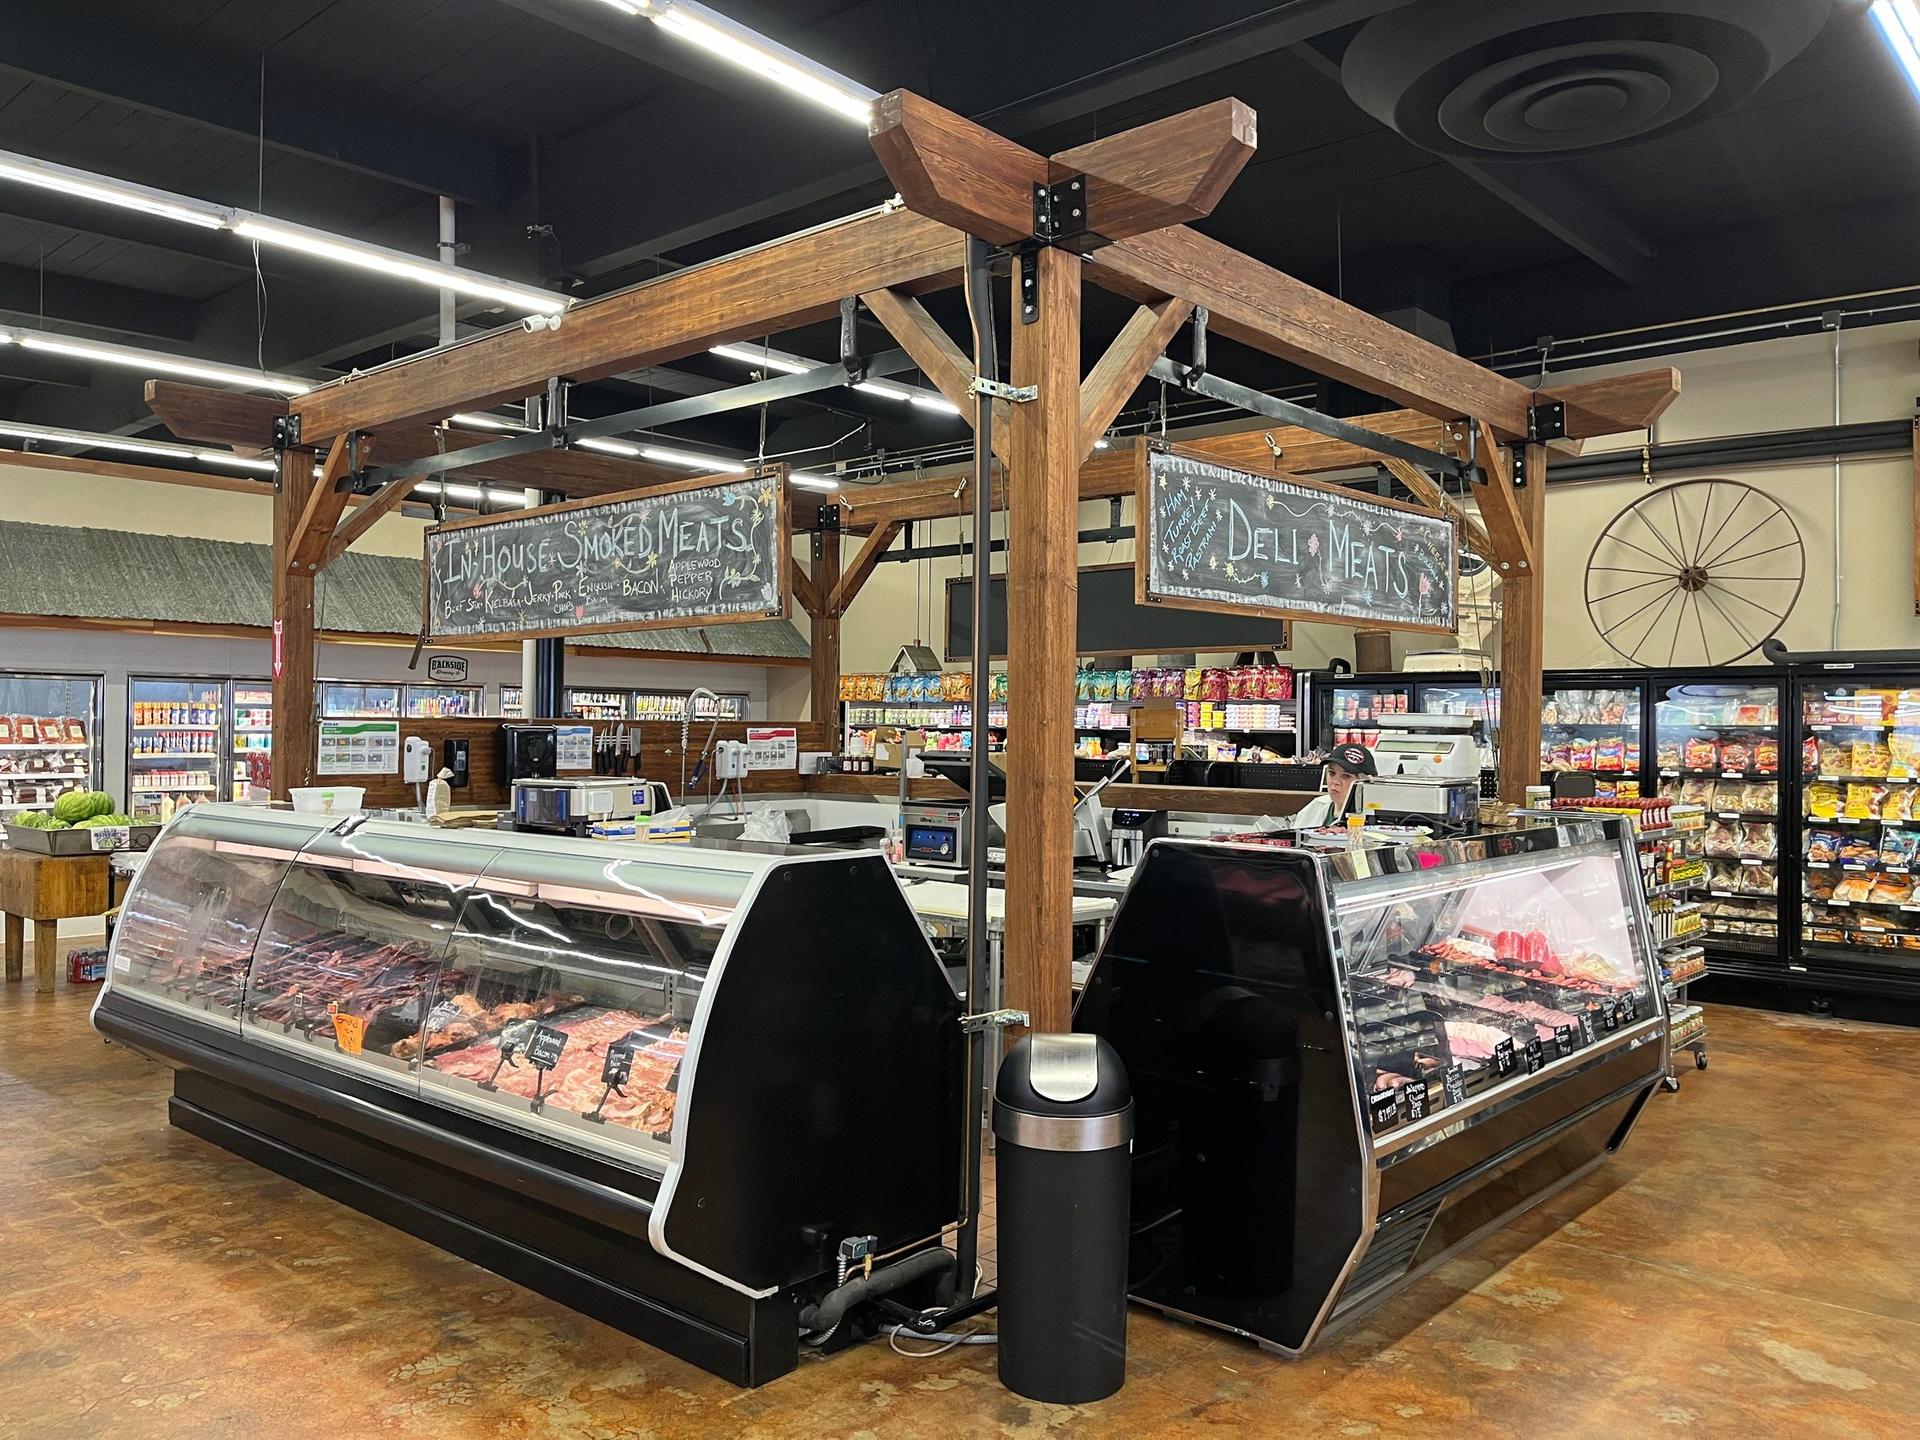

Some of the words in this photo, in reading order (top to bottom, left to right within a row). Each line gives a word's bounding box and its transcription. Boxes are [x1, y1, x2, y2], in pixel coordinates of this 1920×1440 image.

[1165, 489, 1187, 516] HAM
[1164, 497, 1196, 542] TURKEY
[1171, 531, 1191, 564] ROAST
[1190, 498, 1210, 536] BEEF
[557, 520, 653, 568] SMOKED
[658, 507, 751, 558] MEATS
[1185, 521, 1217, 571] PASTRAMI
[1228, 498, 1299, 565] DELI
[1328, 519, 1409, 599] MEATS
[667, 558, 721, 576] APPLEWOOD
[668, 570, 713, 587] PEPPER
[622, 568, 659, 597] BACON
[670, 587, 713, 603] HICKORY
[431, 660, 465, 672] BACKSIDE
